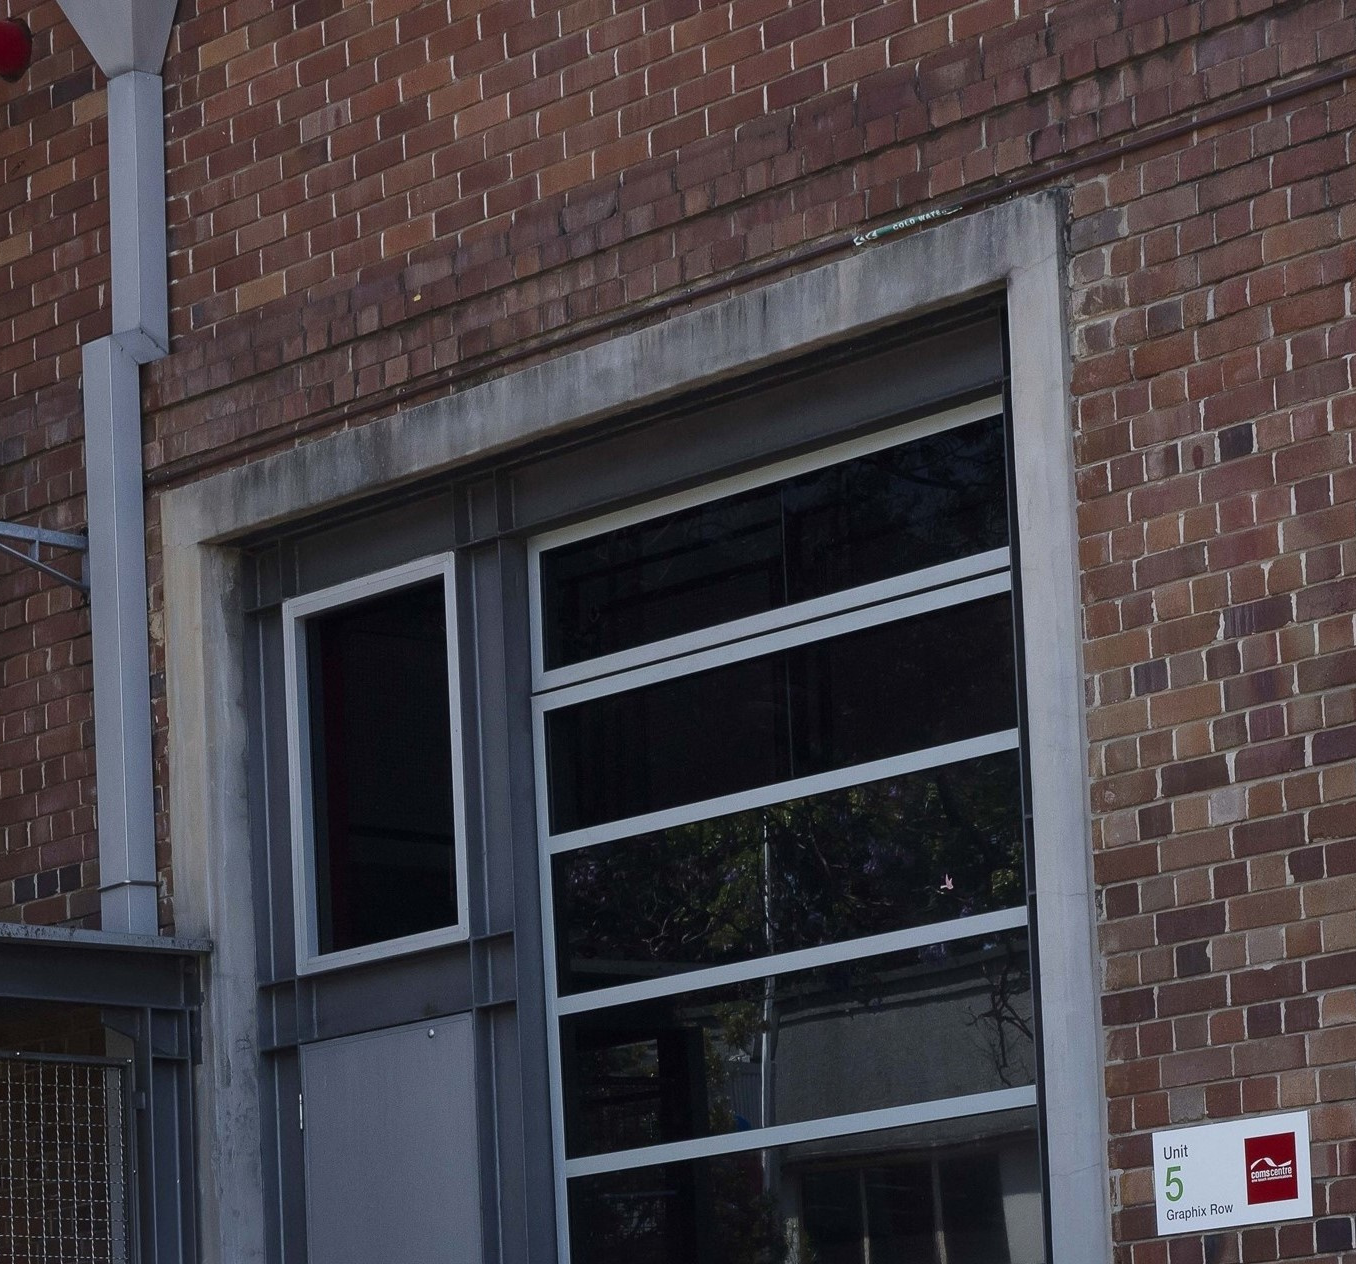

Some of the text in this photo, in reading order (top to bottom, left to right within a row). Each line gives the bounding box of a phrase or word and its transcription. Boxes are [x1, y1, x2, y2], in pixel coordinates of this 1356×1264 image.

[1163, 1144, 1189, 1160] Unit
[1165, 1165, 1184, 1202] 5
[1166, 1203, 1234, 1221] Graphix Row
